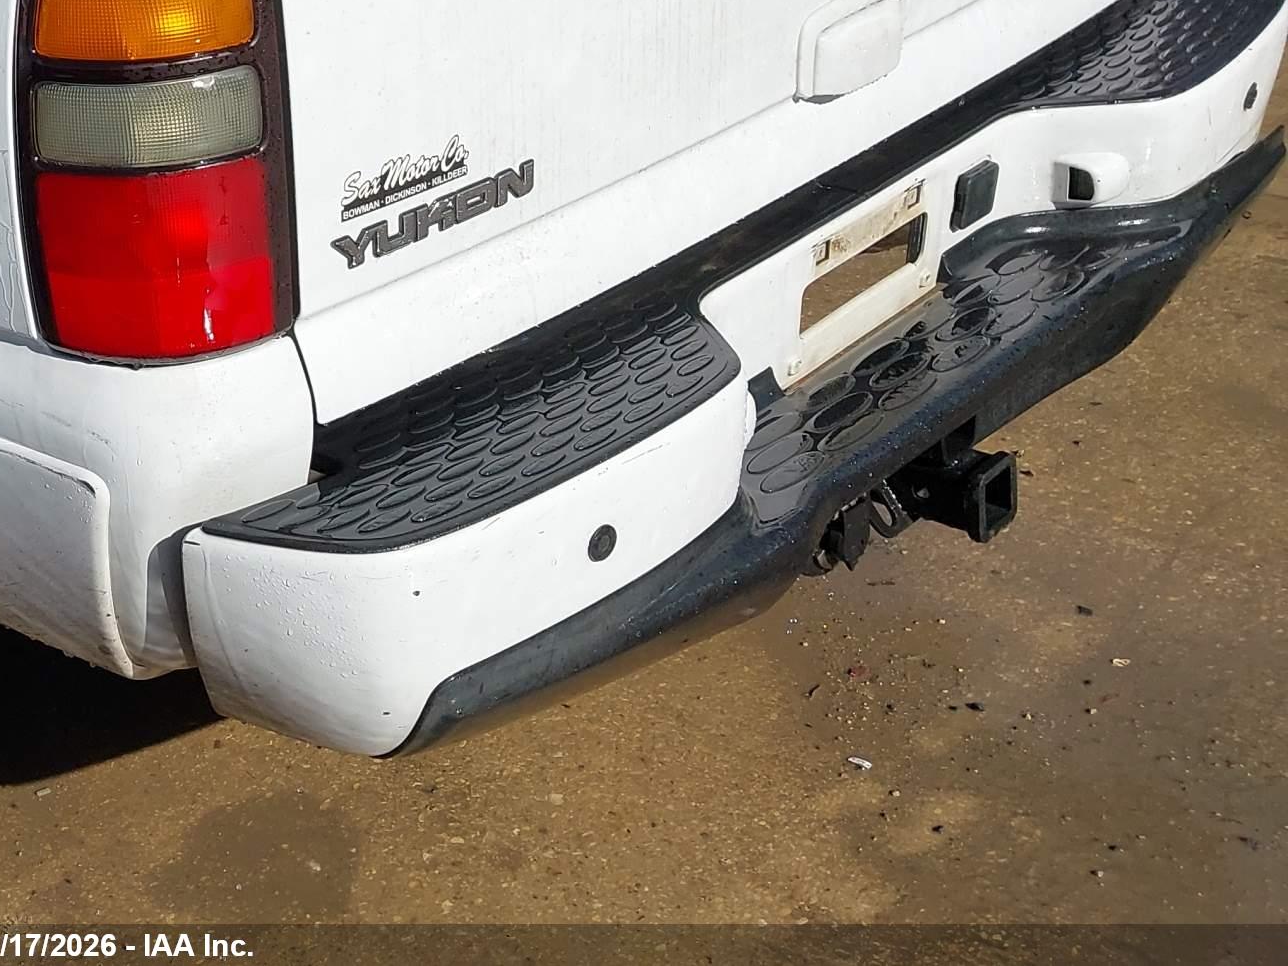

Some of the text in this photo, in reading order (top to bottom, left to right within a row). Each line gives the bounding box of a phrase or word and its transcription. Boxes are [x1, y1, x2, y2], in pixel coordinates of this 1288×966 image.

[341, 170, 382, 206] Sax
[380, 154, 441, 192] Motor
[342, 165, 469, 220] BOWMAN DICKINSON KILLDEER
[330, 158, 535, 270] YUKON
